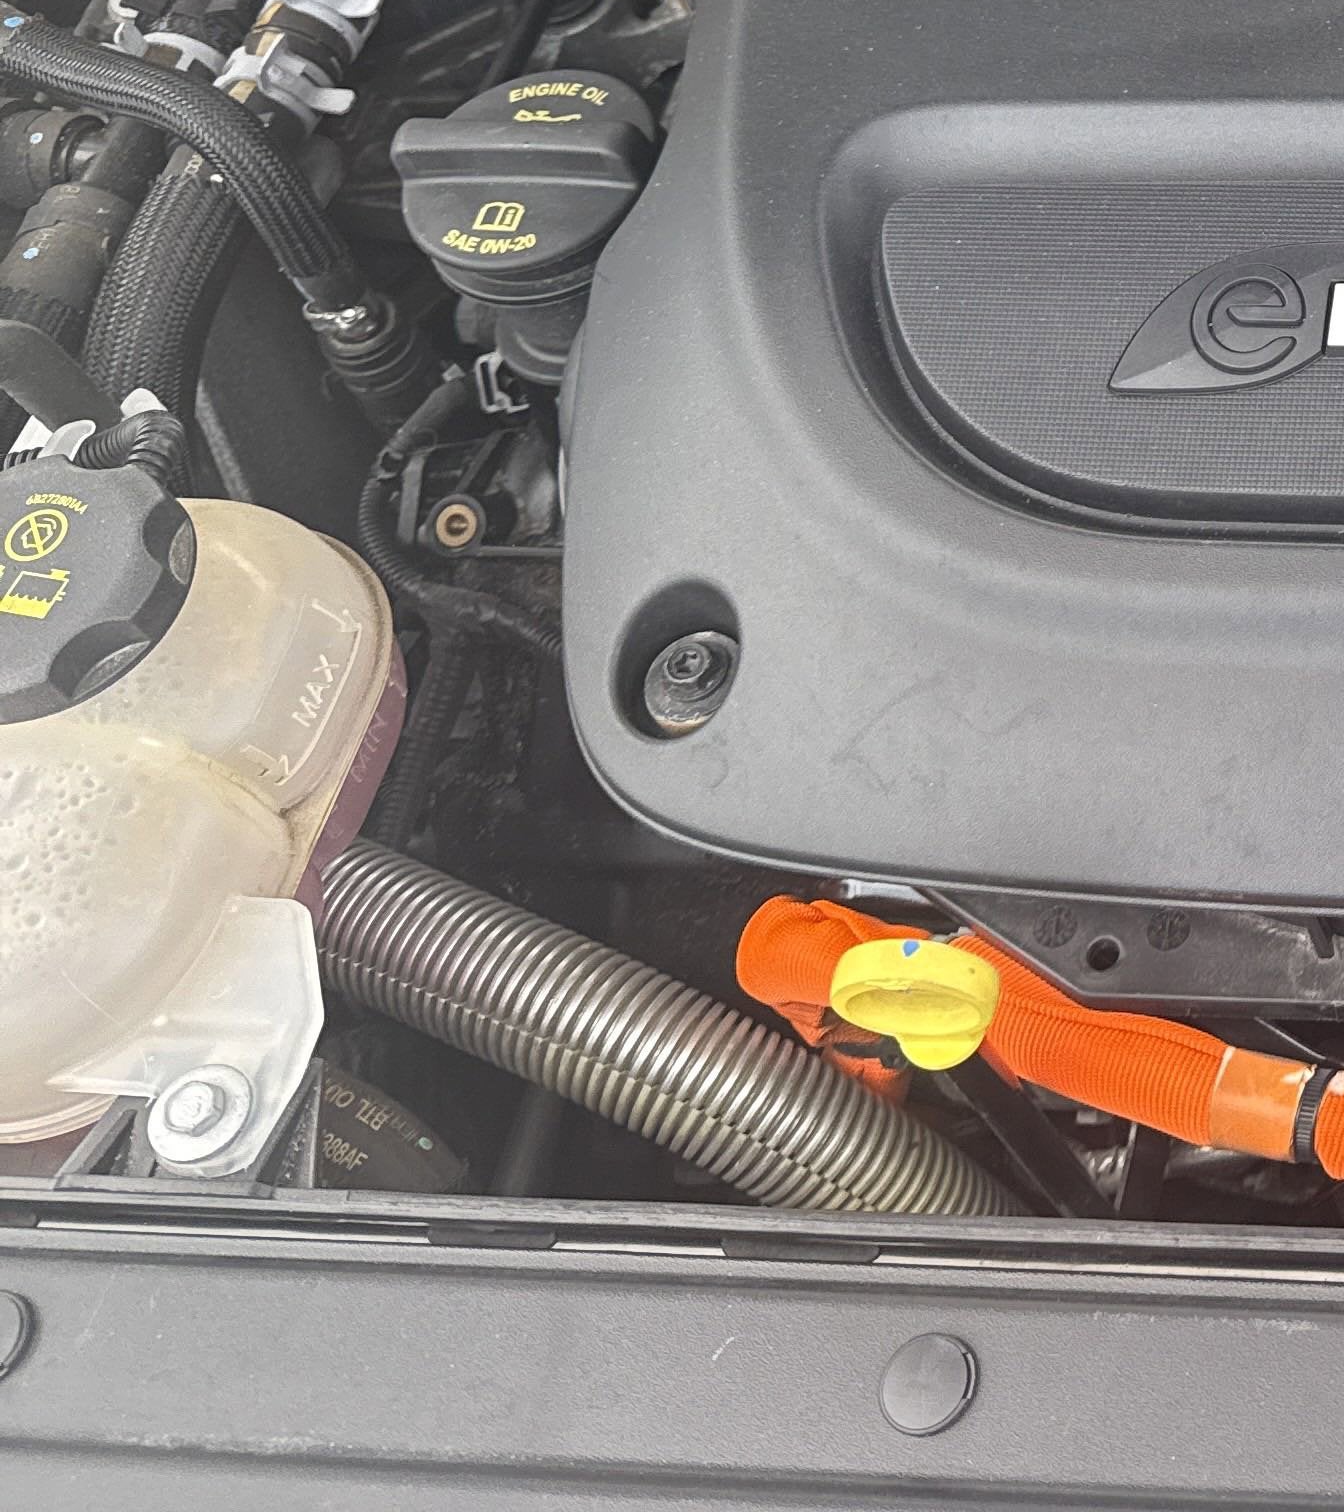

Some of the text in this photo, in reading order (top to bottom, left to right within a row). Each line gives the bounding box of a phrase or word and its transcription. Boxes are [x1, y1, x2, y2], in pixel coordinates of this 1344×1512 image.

[509, 83, 609, 106] ENGINE OIL
[443, 229, 537, 255] SAE 0W-20
[291, 654, 340, 728] MAX
[349, 711, 387, 785] MIN
